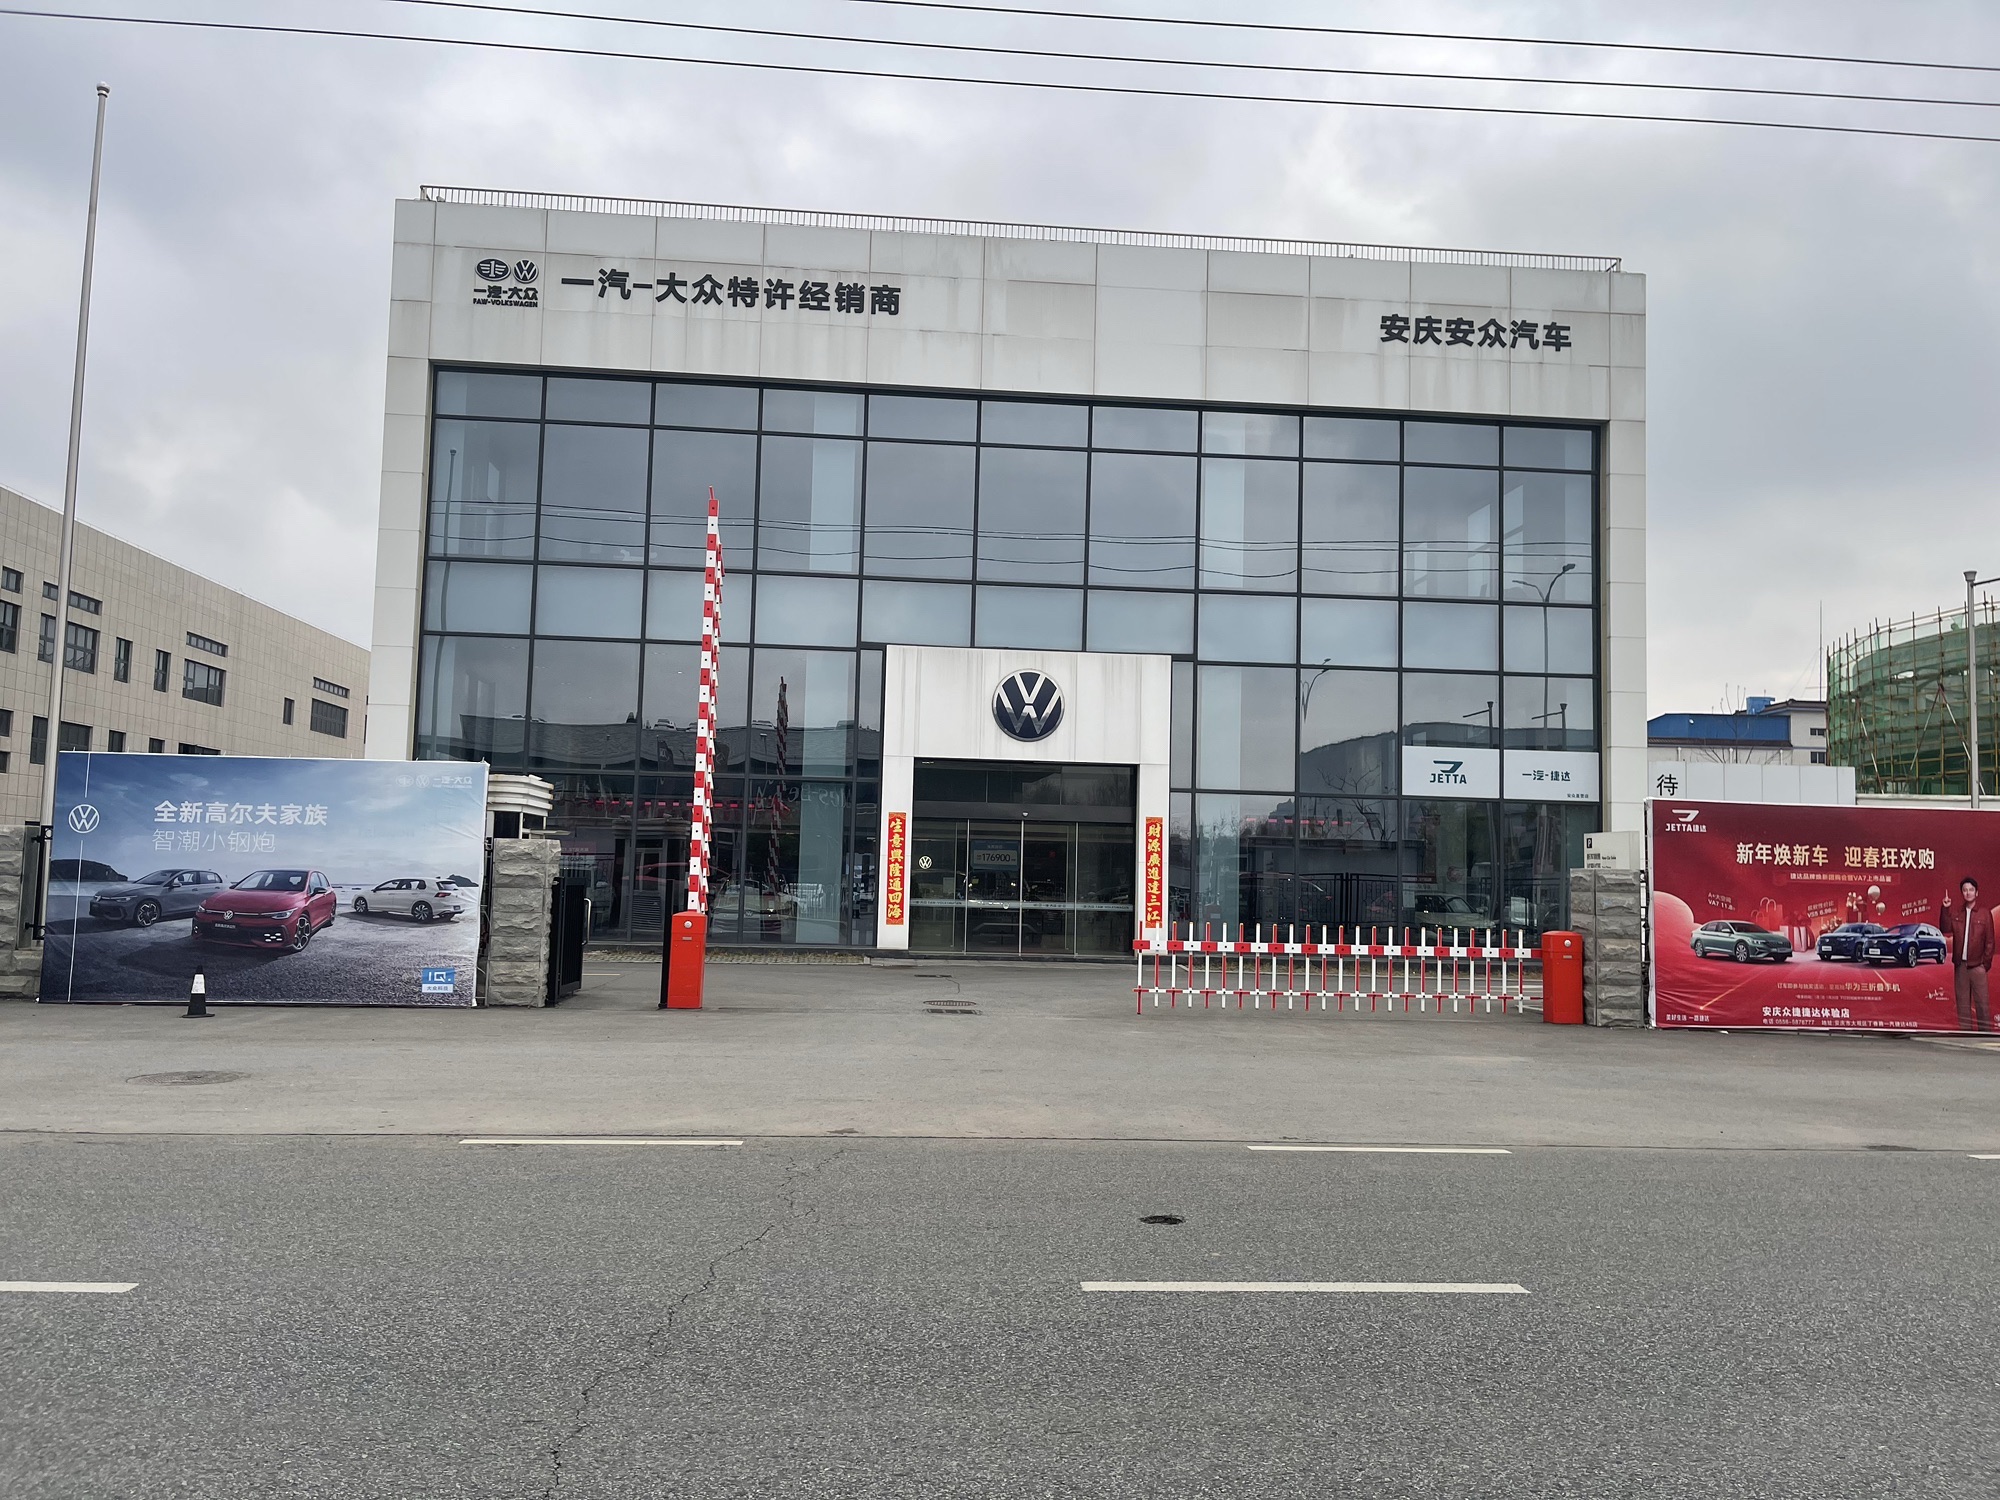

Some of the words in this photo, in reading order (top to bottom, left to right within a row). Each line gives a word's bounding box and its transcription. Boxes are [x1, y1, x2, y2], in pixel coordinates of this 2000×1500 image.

[472, 298, 538, 308] FAW-VOLKSWAGEN
[1380, 314, 1572, 352] 安庆安众汽车
[1429, 773, 1467, 785] JETTA
[1656, 773, 1679, 796] 待
[154, 800, 328, 826] 全新高尔夫家族
[152, 829, 276, 853] 智潮小钢炮
[982, 853, 1010, 862] 176900
[1736, 842, 1829, 867] 新年焕新车
[1844, 845, 1935, 870] 迎春狂欢购
[1762, 1006, 1850, 1018] 安庆众捷捷达体验店
